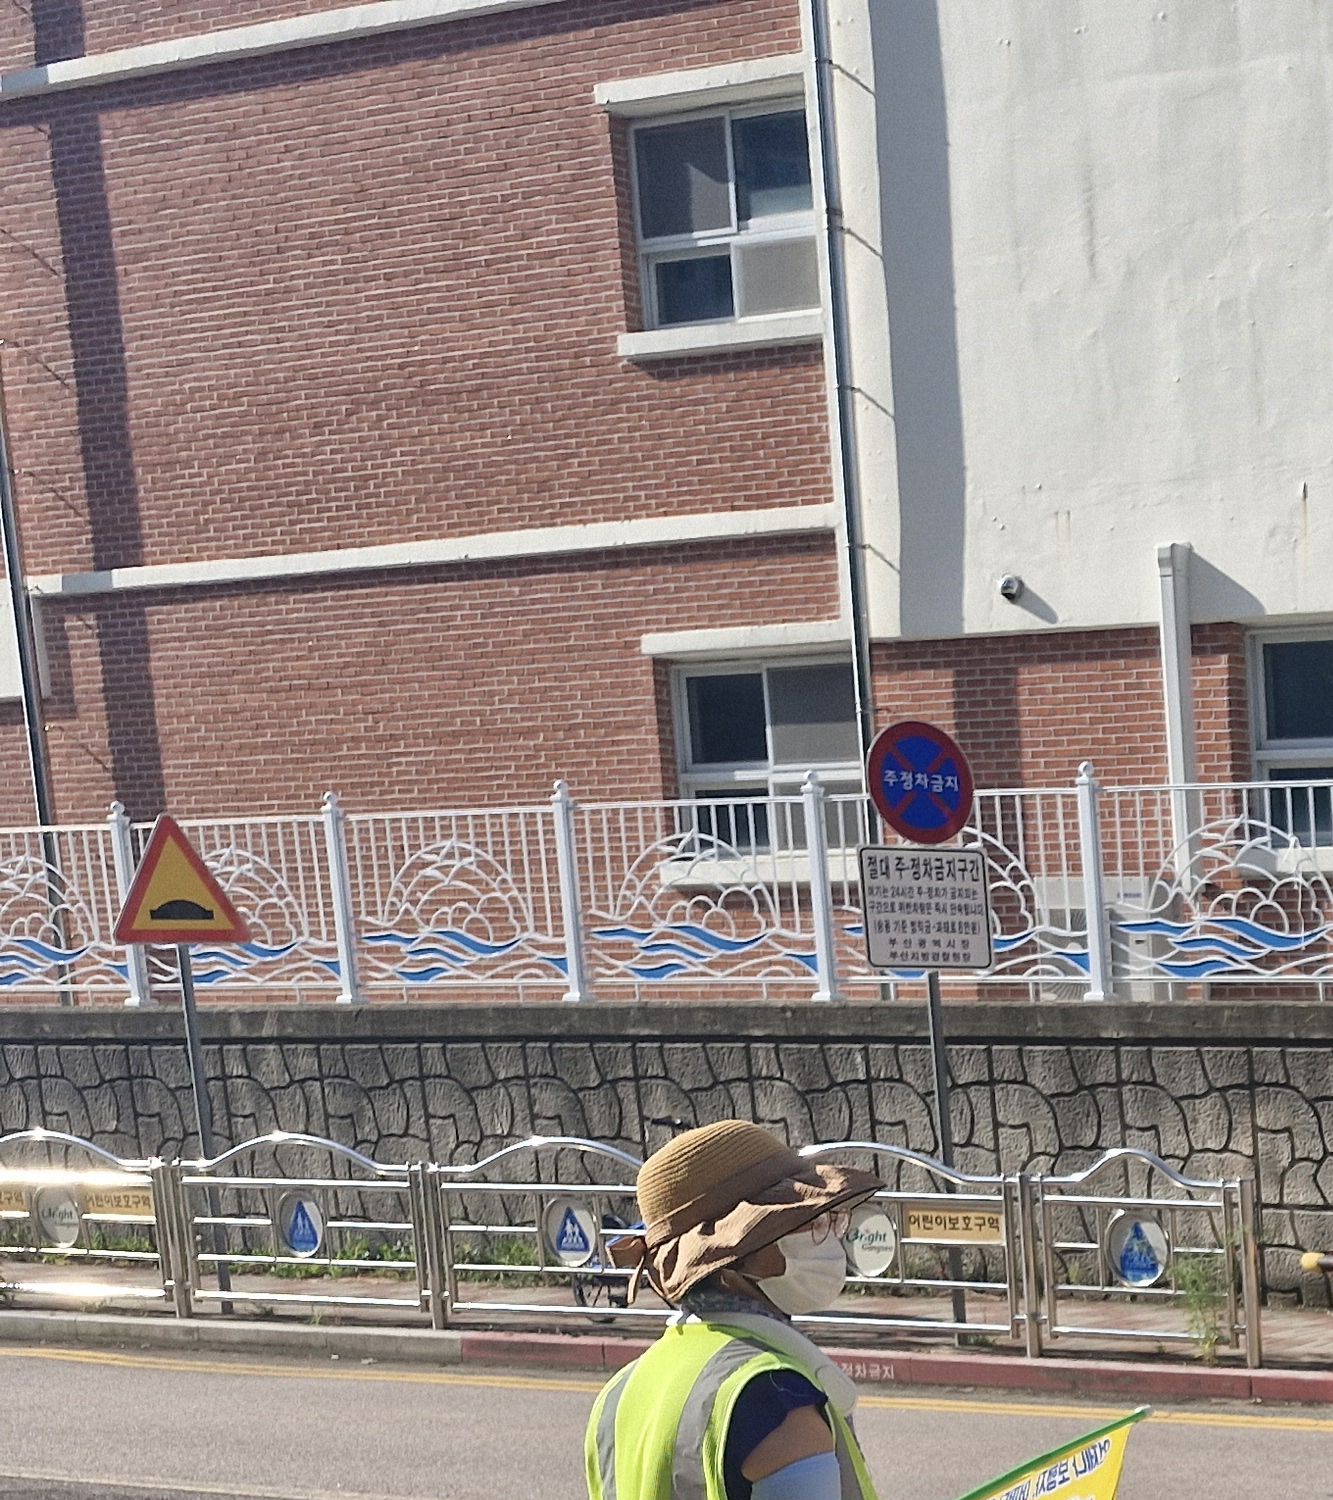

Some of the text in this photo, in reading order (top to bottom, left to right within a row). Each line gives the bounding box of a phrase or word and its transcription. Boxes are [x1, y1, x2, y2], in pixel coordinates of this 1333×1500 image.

[884, 769, 959, 793] 주정차금지
[867, 855, 891, 880] 절대
[909, 1213, 1000, 1233] 어린이보호구역
